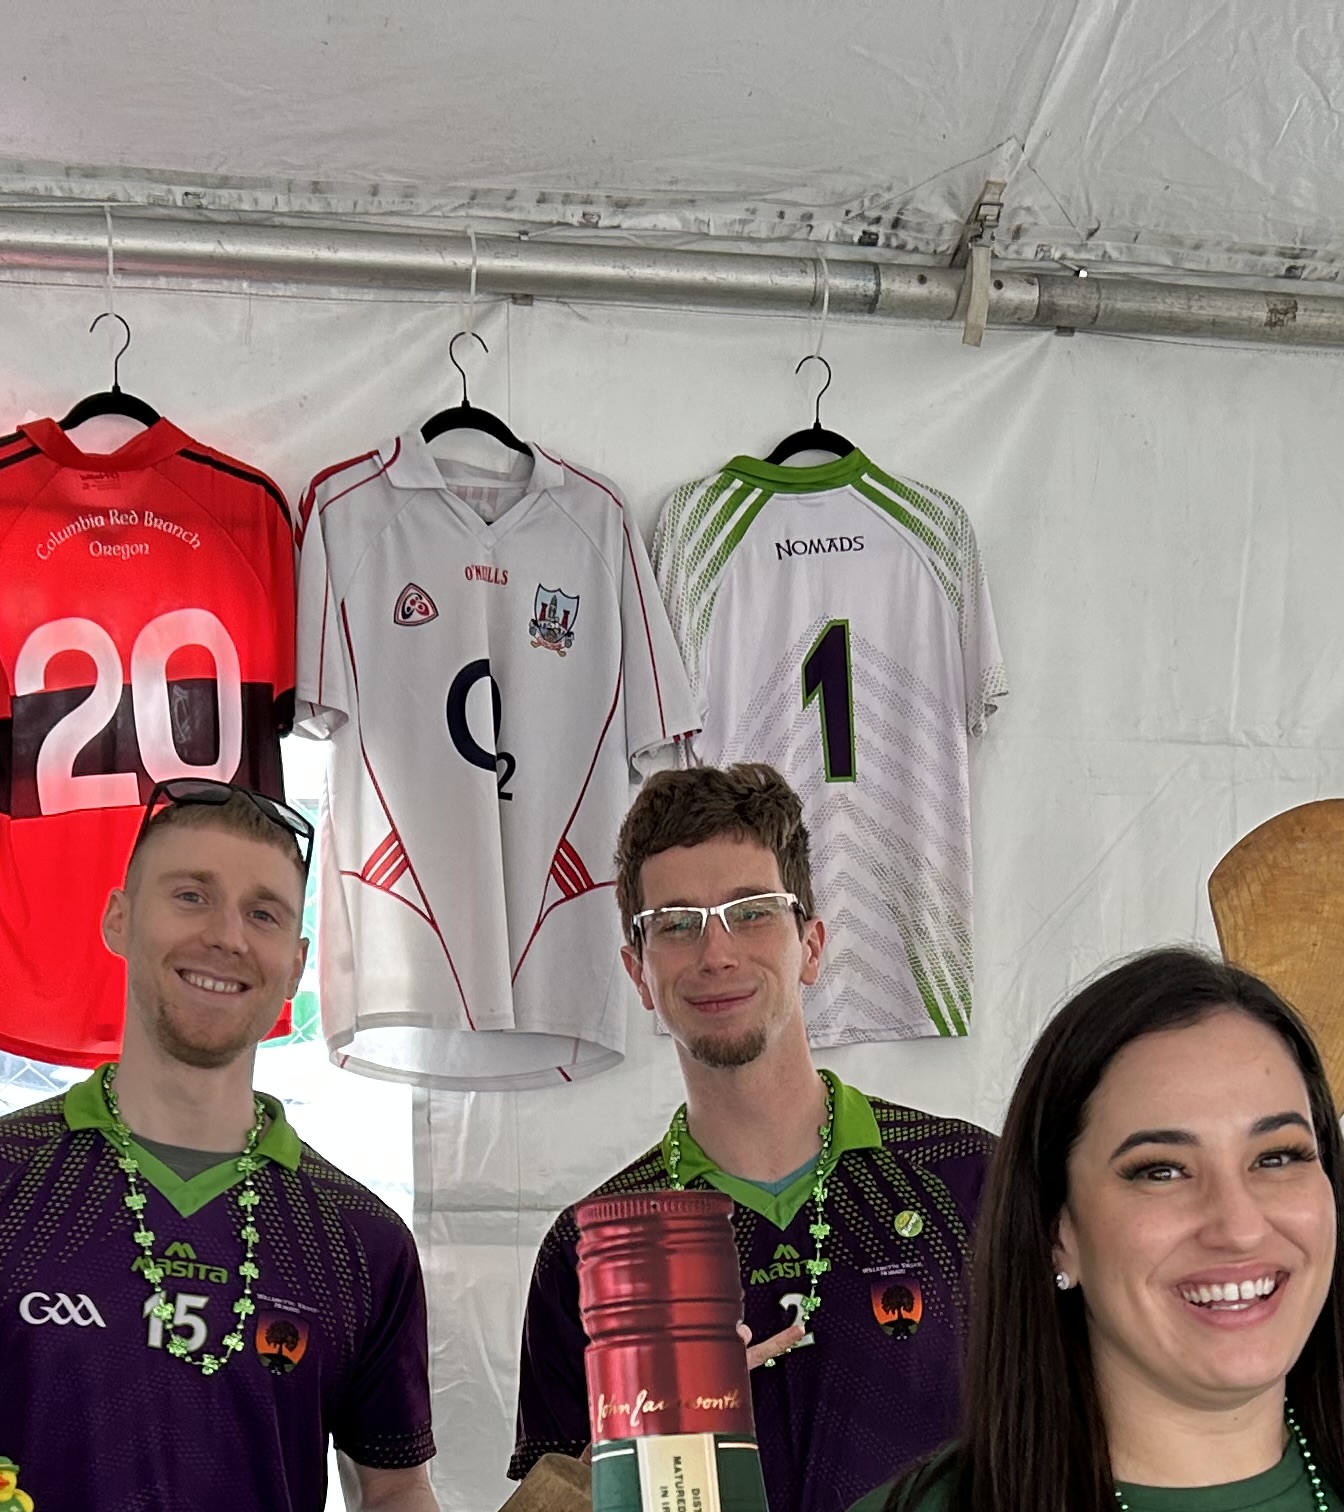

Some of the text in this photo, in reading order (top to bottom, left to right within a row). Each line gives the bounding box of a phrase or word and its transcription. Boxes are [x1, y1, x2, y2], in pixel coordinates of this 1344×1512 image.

[36, 509, 202, 560] Columbia Red Branch
[89, 540, 150, 560] Oregon
[775, 535, 865, 561] NOMADS
[14, 607, 243, 816] 20
[801, 618, 857, 783] 1
[142, 1290, 210, 1352] 15
[660, 1486, 669, 1498] IN
